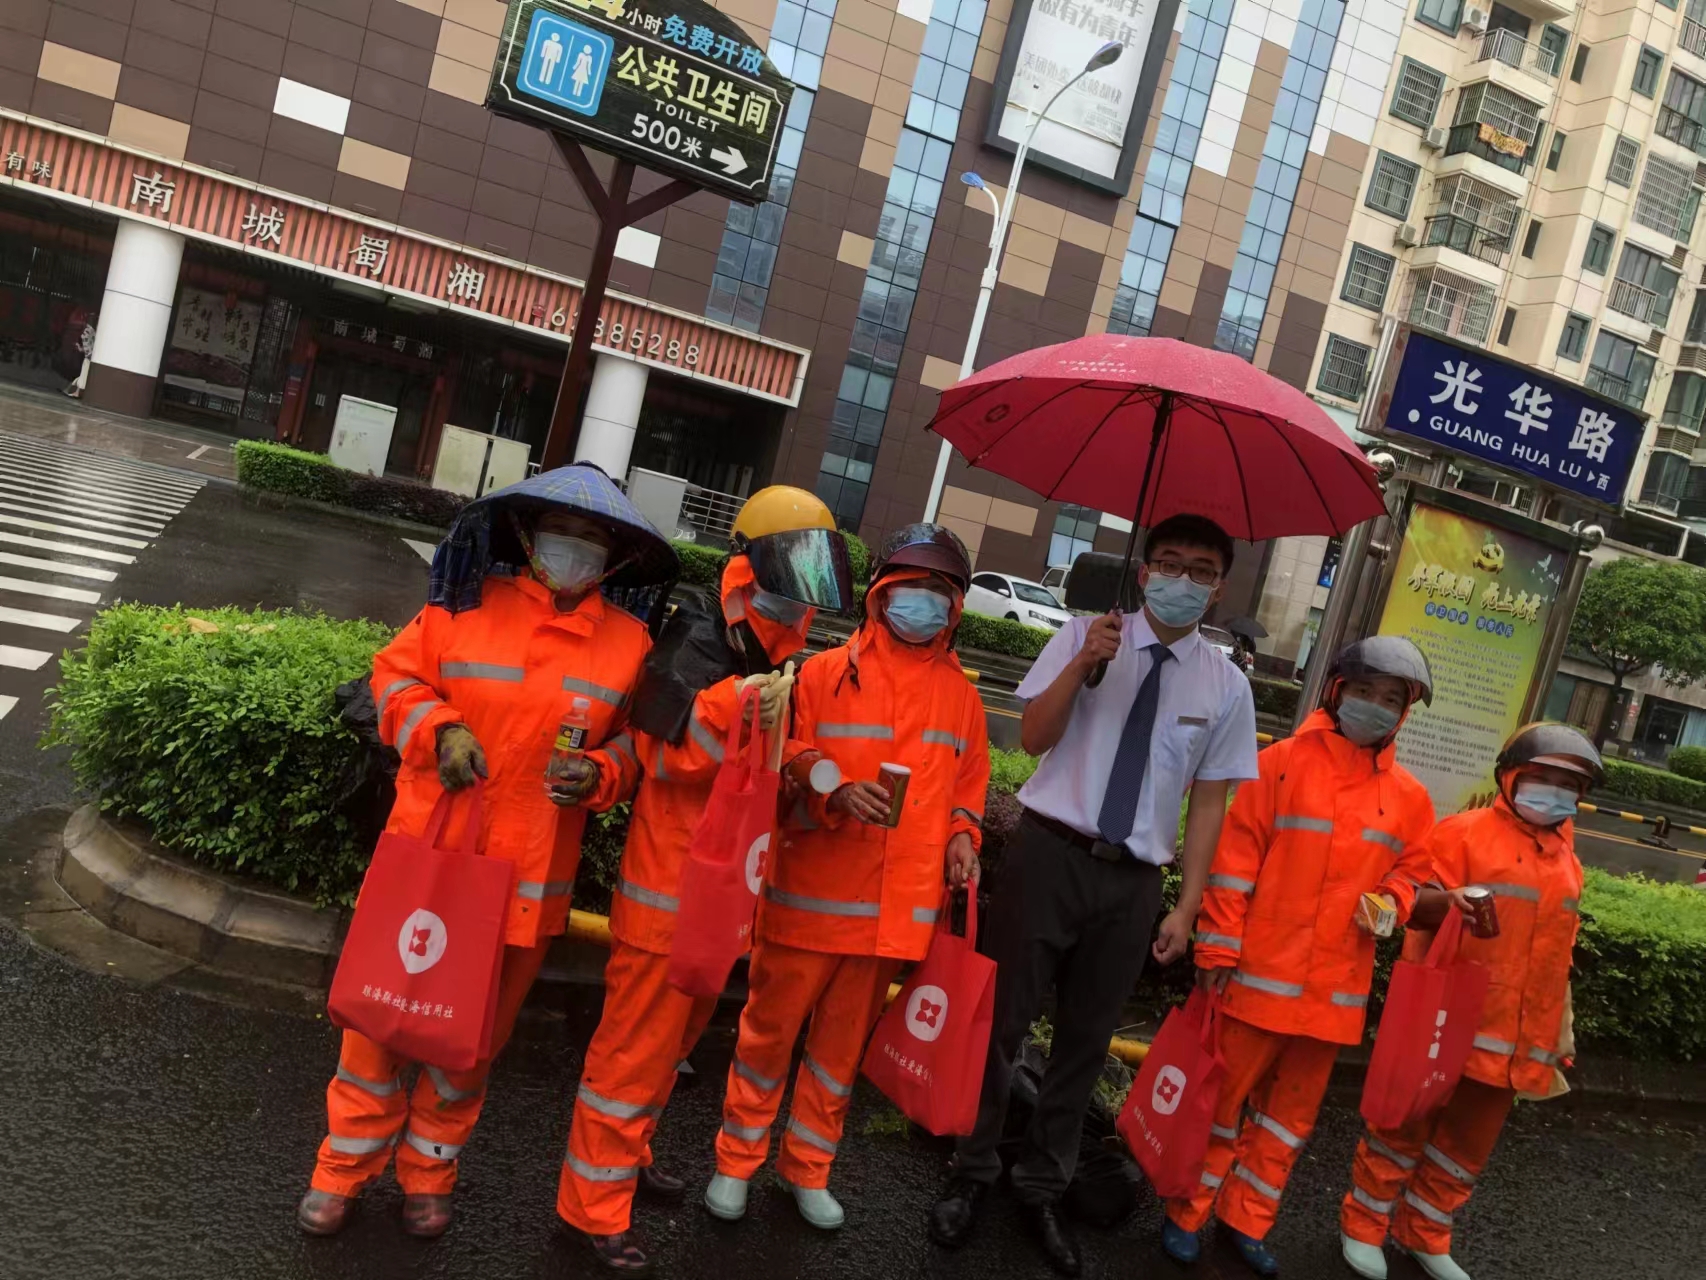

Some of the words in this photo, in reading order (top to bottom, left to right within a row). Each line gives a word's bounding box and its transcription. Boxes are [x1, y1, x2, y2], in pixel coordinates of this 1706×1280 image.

[617, 45, 771, 135] 公共卫生间
[654, 99, 720, 133] TOILET
[631, 113, 703, 159] 500米
[4, 151, 52, 178] 有味
[130, 171, 486, 302] 南城蜀湘
[551, 307, 699, 364] 685288
[333, 320, 433, 359] 南城蜀湘
[1429, 360, 1618, 463] 光华路
[1430, 415, 1503, 450] GUANG
[1511, 442, 1550, 468] HUA
[1558, 459, 1581, 478] LU
[1597, 472, 1610, 491] 西
